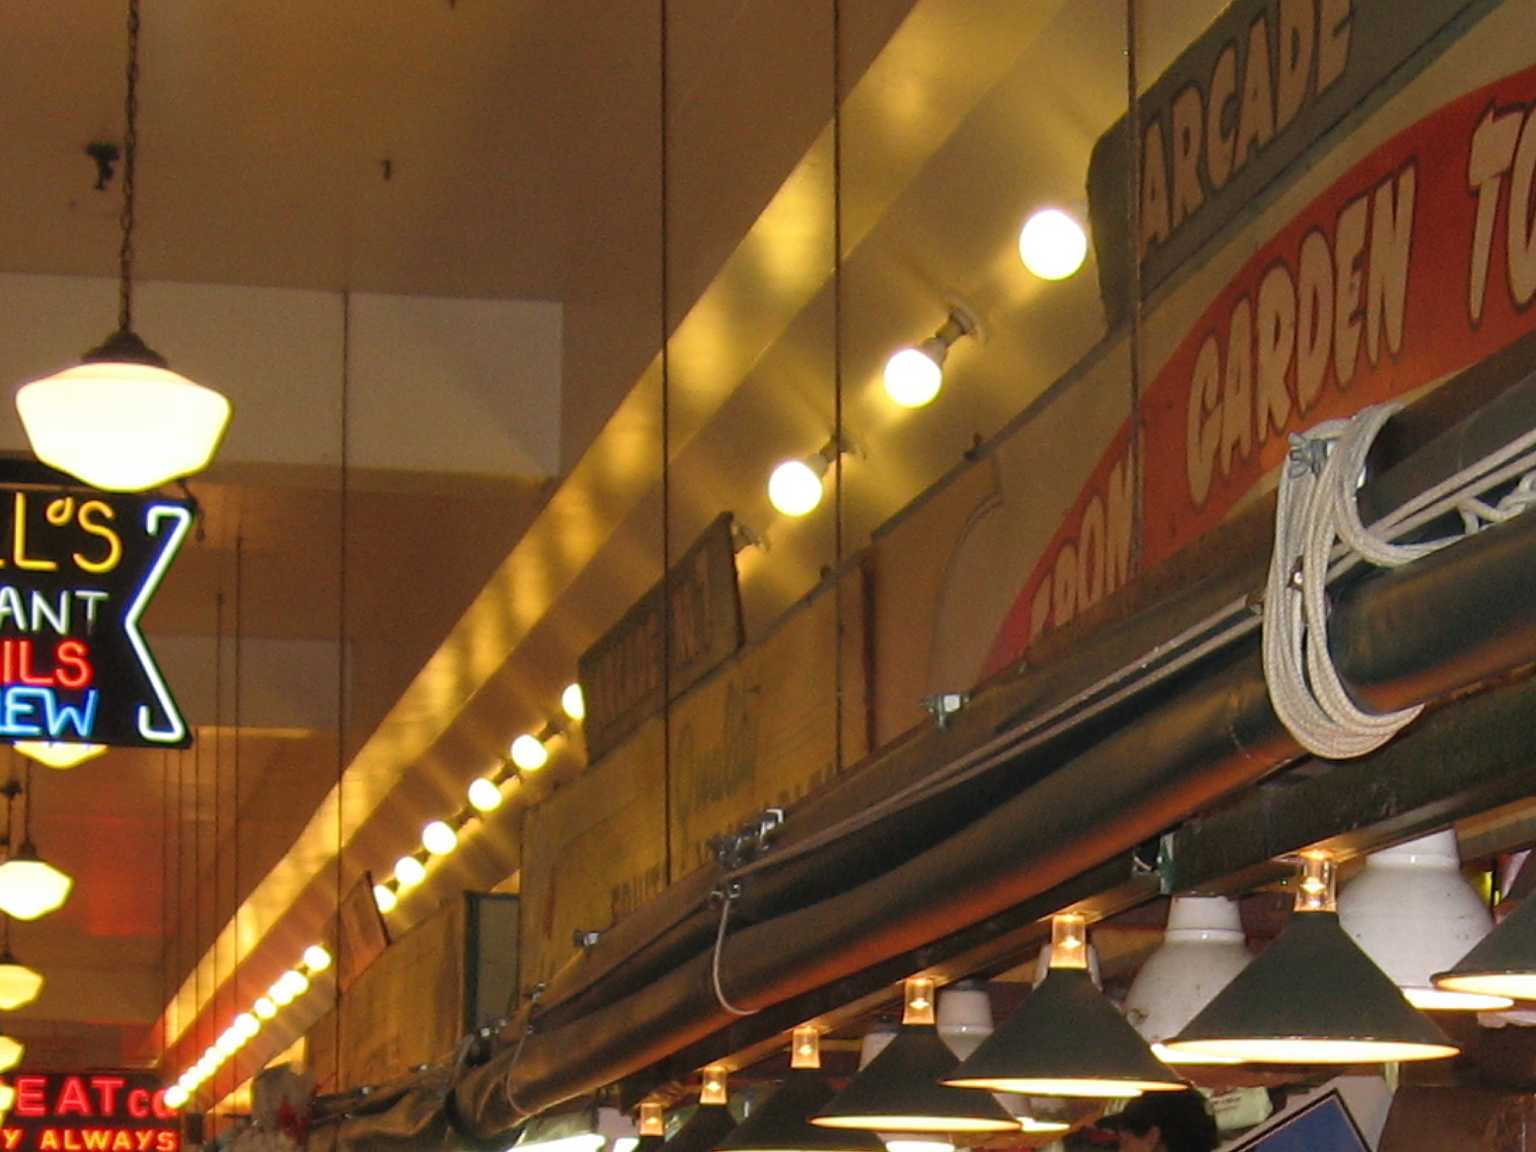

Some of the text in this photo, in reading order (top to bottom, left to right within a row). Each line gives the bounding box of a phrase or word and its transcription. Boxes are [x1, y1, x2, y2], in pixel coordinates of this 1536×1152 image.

[1140, 0, 1353, 247] ARCADE
[1186, 158, 1418, 508] GARDEN
[39, 1128, 178, 1152] ALWAYS
